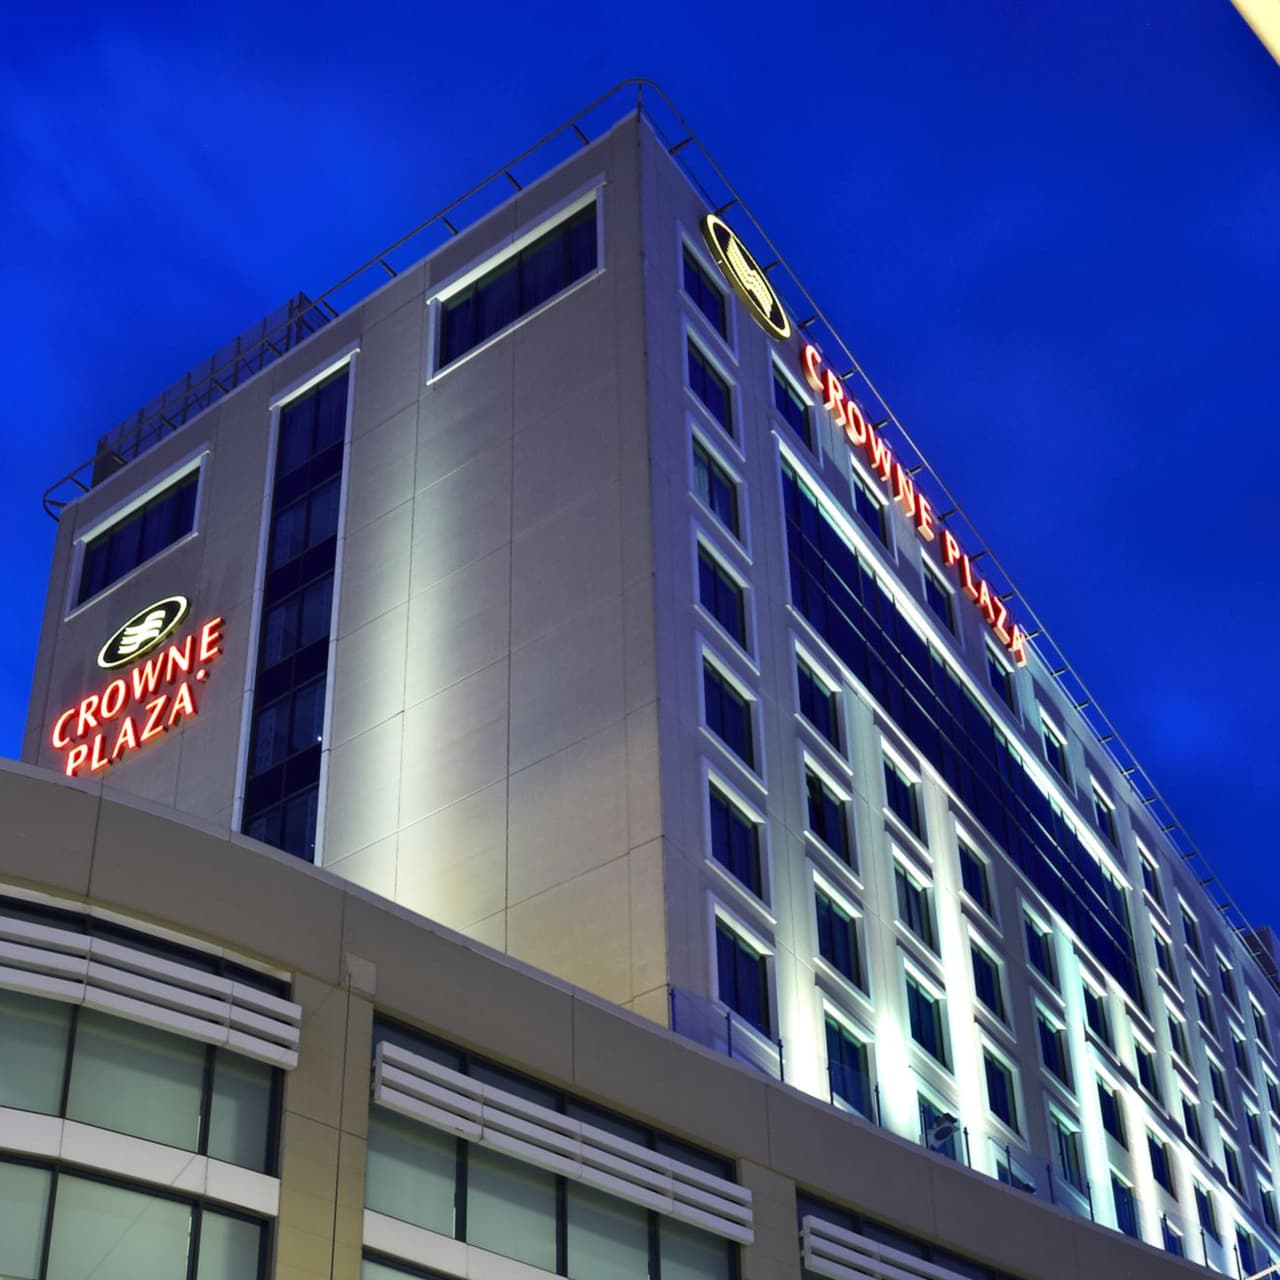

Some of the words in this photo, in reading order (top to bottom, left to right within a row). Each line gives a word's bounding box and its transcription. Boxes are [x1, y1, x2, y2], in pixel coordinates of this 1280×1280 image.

[800, 343, 934, 542] CROWNE
[941, 530, 1028, 668] PLAZA
[51, 616, 226, 750] CROWNE
[65, 683, 197, 777] PLAZA
